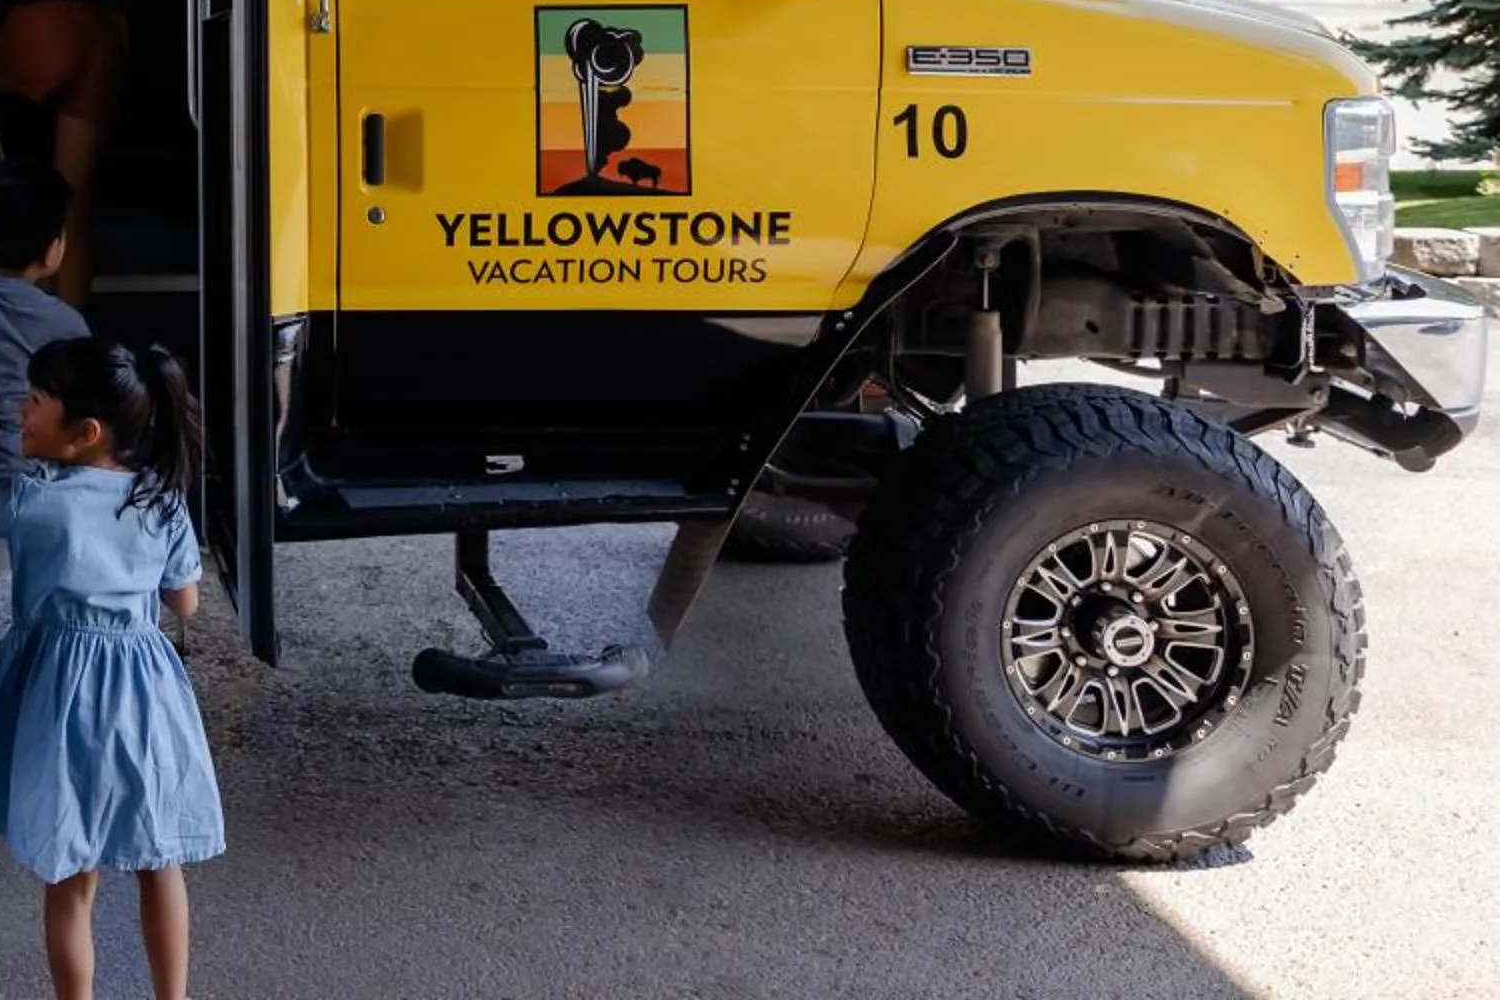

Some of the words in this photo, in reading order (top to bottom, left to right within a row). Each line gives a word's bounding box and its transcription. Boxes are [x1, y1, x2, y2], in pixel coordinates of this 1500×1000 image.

[893, 103, 968, 158] 10
[436, 211, 792, 247] YELLOWSTONE
[468, 258, 641, 285] VACATION
[652, 257, 767, 284] TOURS
